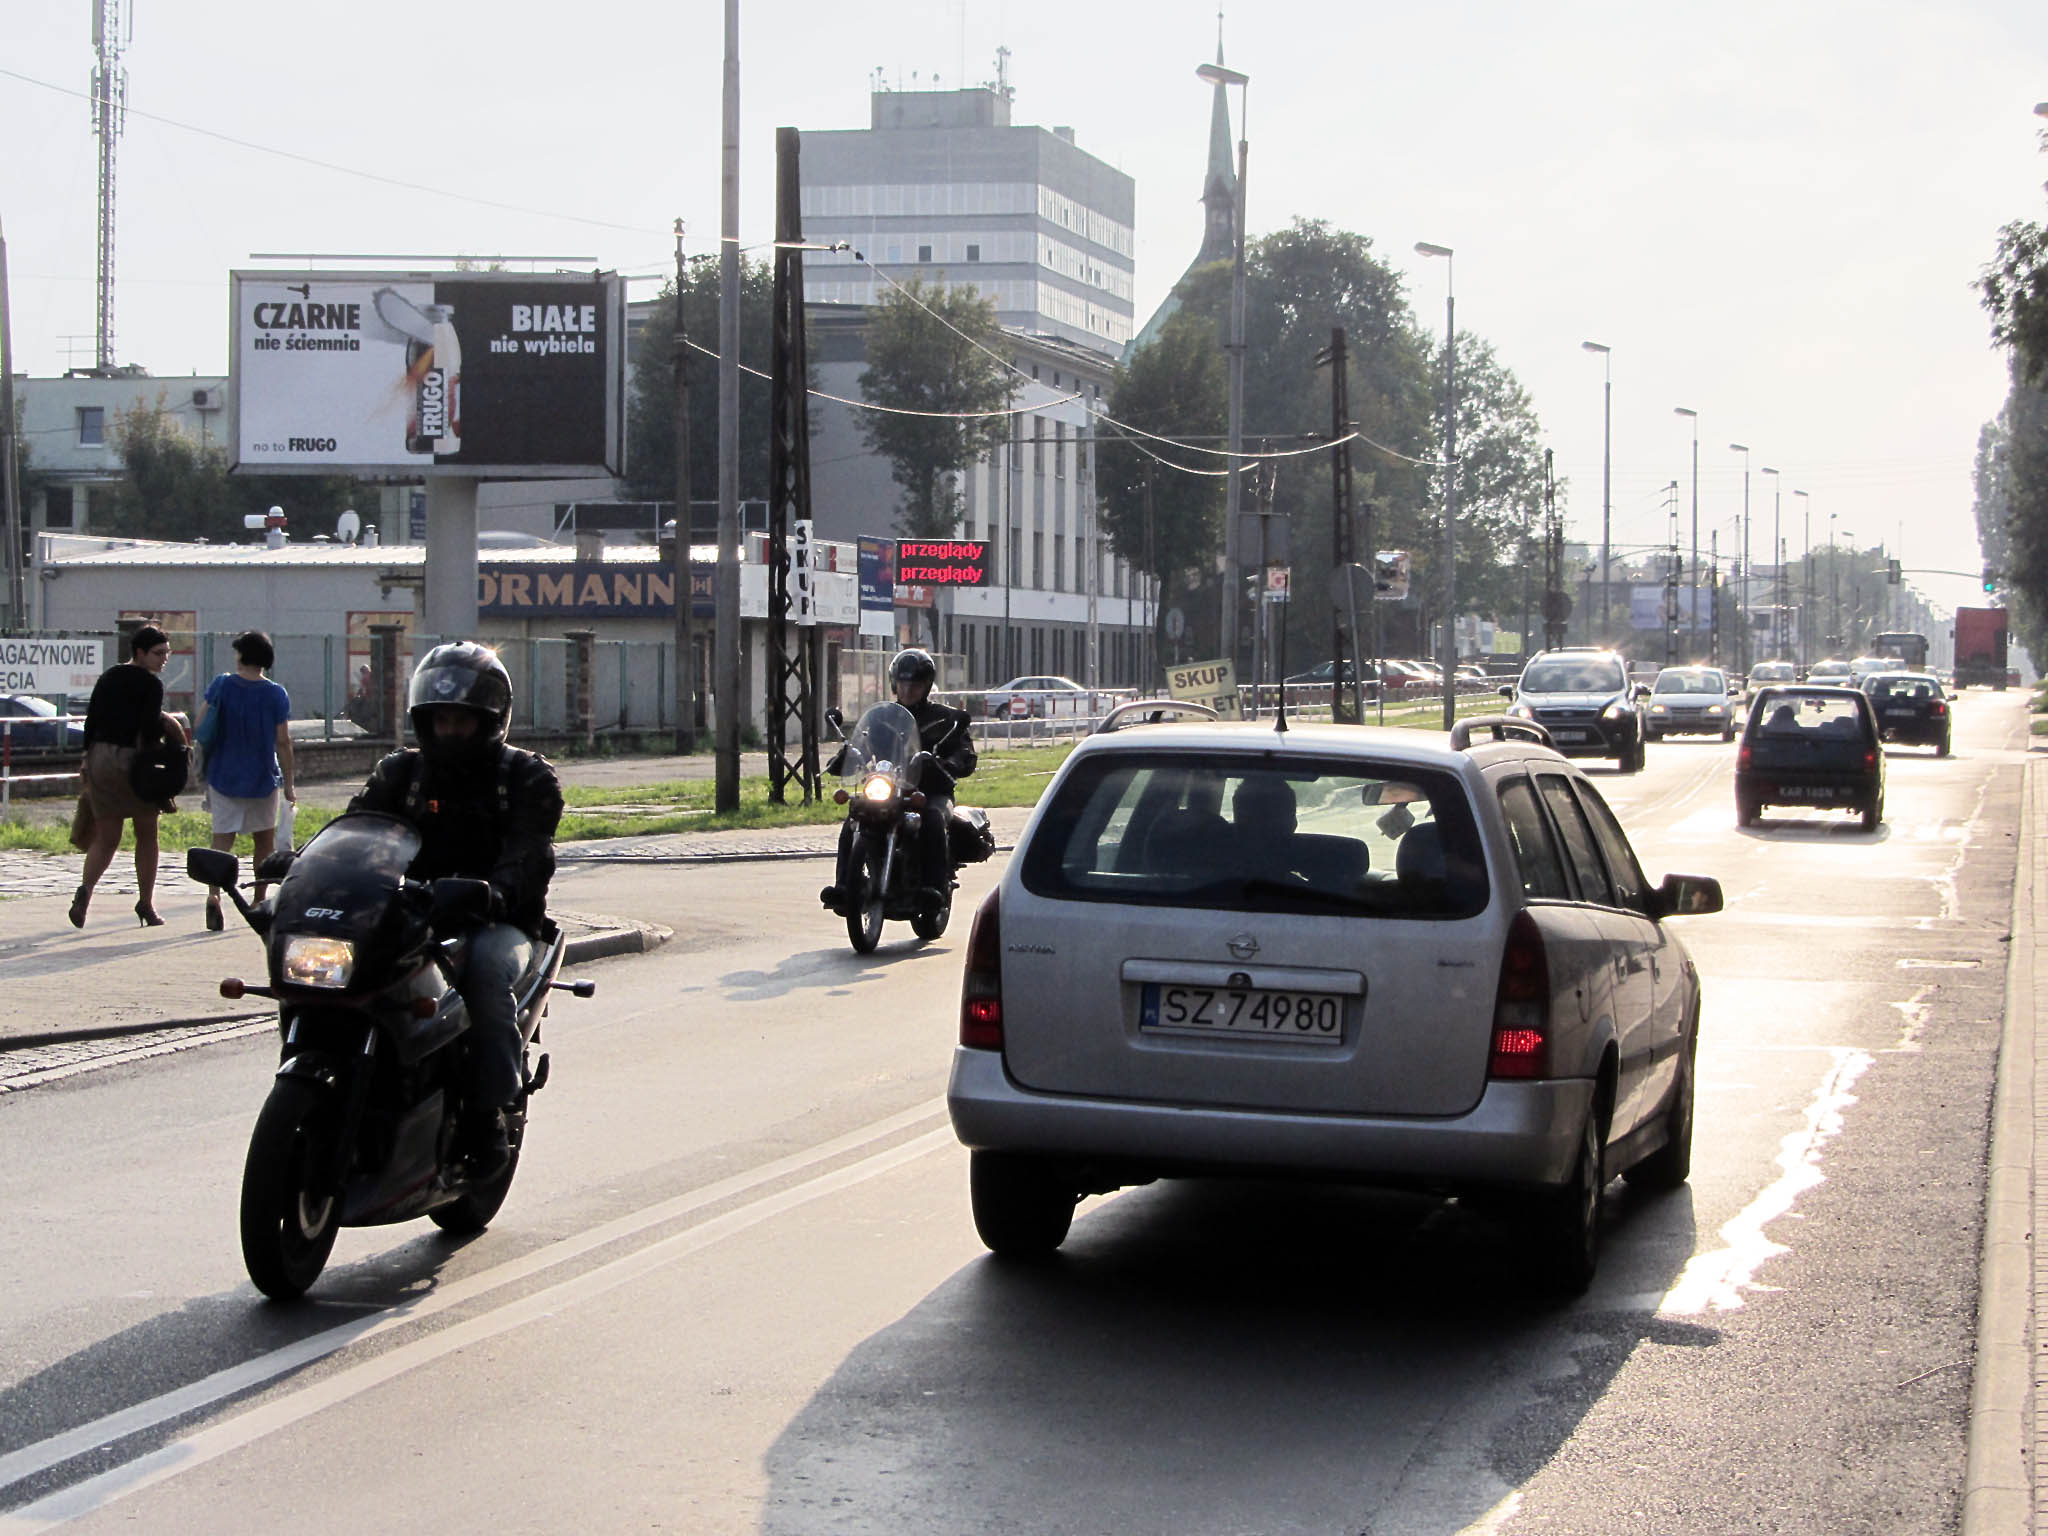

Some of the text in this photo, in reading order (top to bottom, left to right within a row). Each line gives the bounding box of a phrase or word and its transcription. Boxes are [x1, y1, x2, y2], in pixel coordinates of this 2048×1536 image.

[253, 302, 361, 330] CZARNE
[512, 304, 596, 332] BIAŁE
[253, 333, 361, 351] nie ściemnia
[490, 334, 596, 356] nie wybiela
[422, 370, 444, 437] FRUGO
[253, 437, 337, 452] no to FRUGO
[901, 542, 984, 560] przeglądy
[901, 565, 984, 583] przeglądy
[1174, 665, 1229, 689] SKUP
[305, 907, 344, 920] GPZ
[1166, 990, 1337, 1033] SZ 74980
